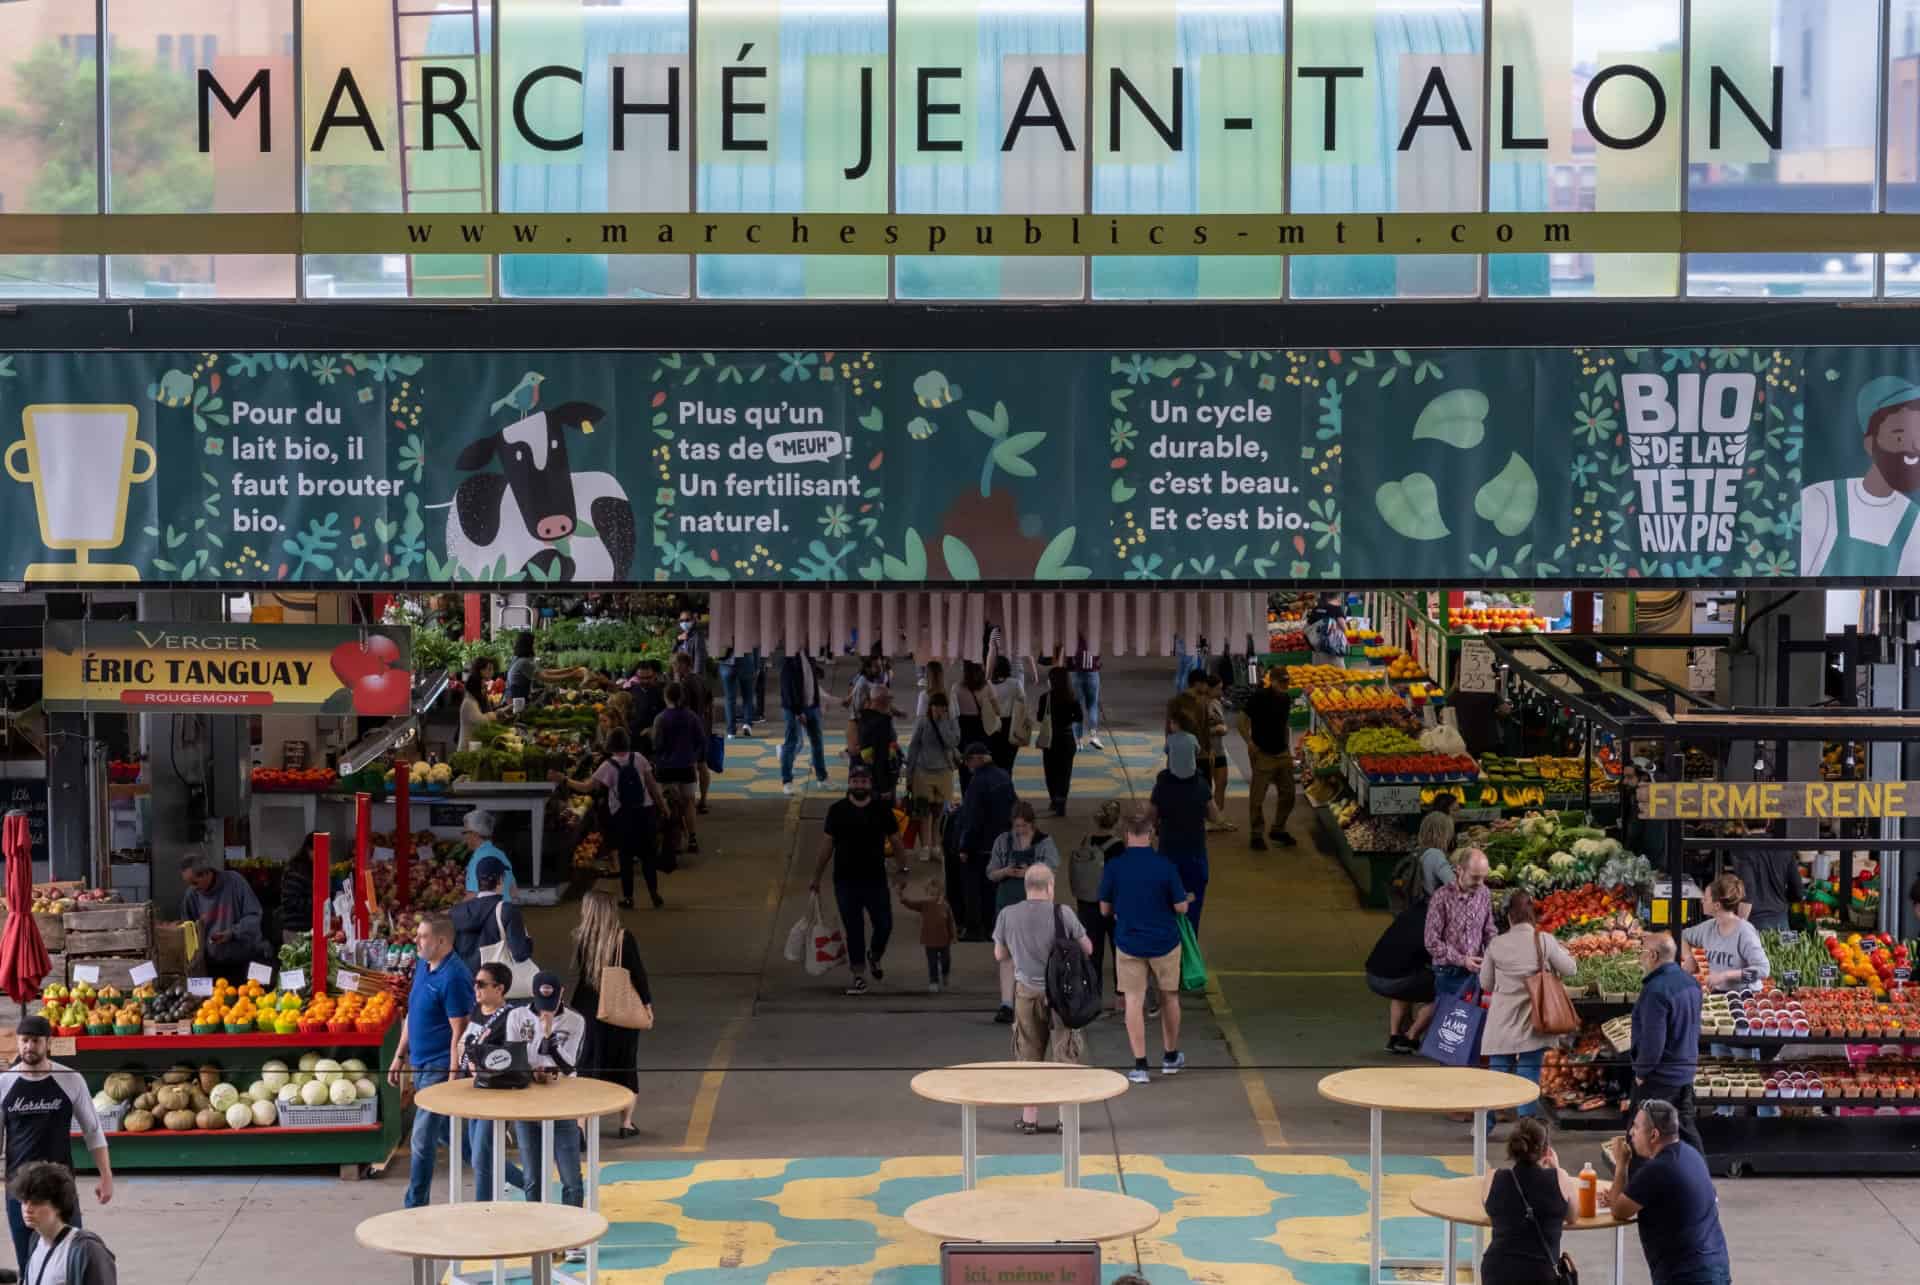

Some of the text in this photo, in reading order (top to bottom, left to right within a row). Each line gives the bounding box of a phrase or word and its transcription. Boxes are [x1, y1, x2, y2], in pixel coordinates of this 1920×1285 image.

[199, 43, 1784, 180] MARCHÉ JEAN-TALON
[232, 401, 342, 425] Pour du
[679, 401, 824, 430] Plus qu’un
[1150, 398, 1272, 428] Un cycle
[1621, 373, 1757, 433] BIO
[232, 437, 363, 465] lait bio, il
[678, 437, 721, 460] tas
[728, 436, 764, 460] de
[1149, 434, 1268, 463] durable,
[1652, 435, 1725, 464] DE LA
[232, 472, 404, 497] faut brouter
[679, 472, 861, 497] Un fertilisant
[1149, 470, 1300, 495] c’est beau.
[1633, 463, 1743, 513] TÊTE
[233, 508, 286, 532] bio.
[680, 508, 790, 533] naturel.
[1150, 506, 1312, 530] Et c’est bio.
[1639, 513, 1735, 553] AUX PIS
[135, 630, 261, 650] VERGER
[82, 653, 313, 686] ÉRIC TANGUAY
[144, 693, 249, 704] ROUGEMONT
[1648, 783, 1907, 819] FERME RENE
[8, 1096, 63, 1112] Marshall
[997, 1265, 1055, 1281] même
[1061, 1265, 1076, 1281] le
